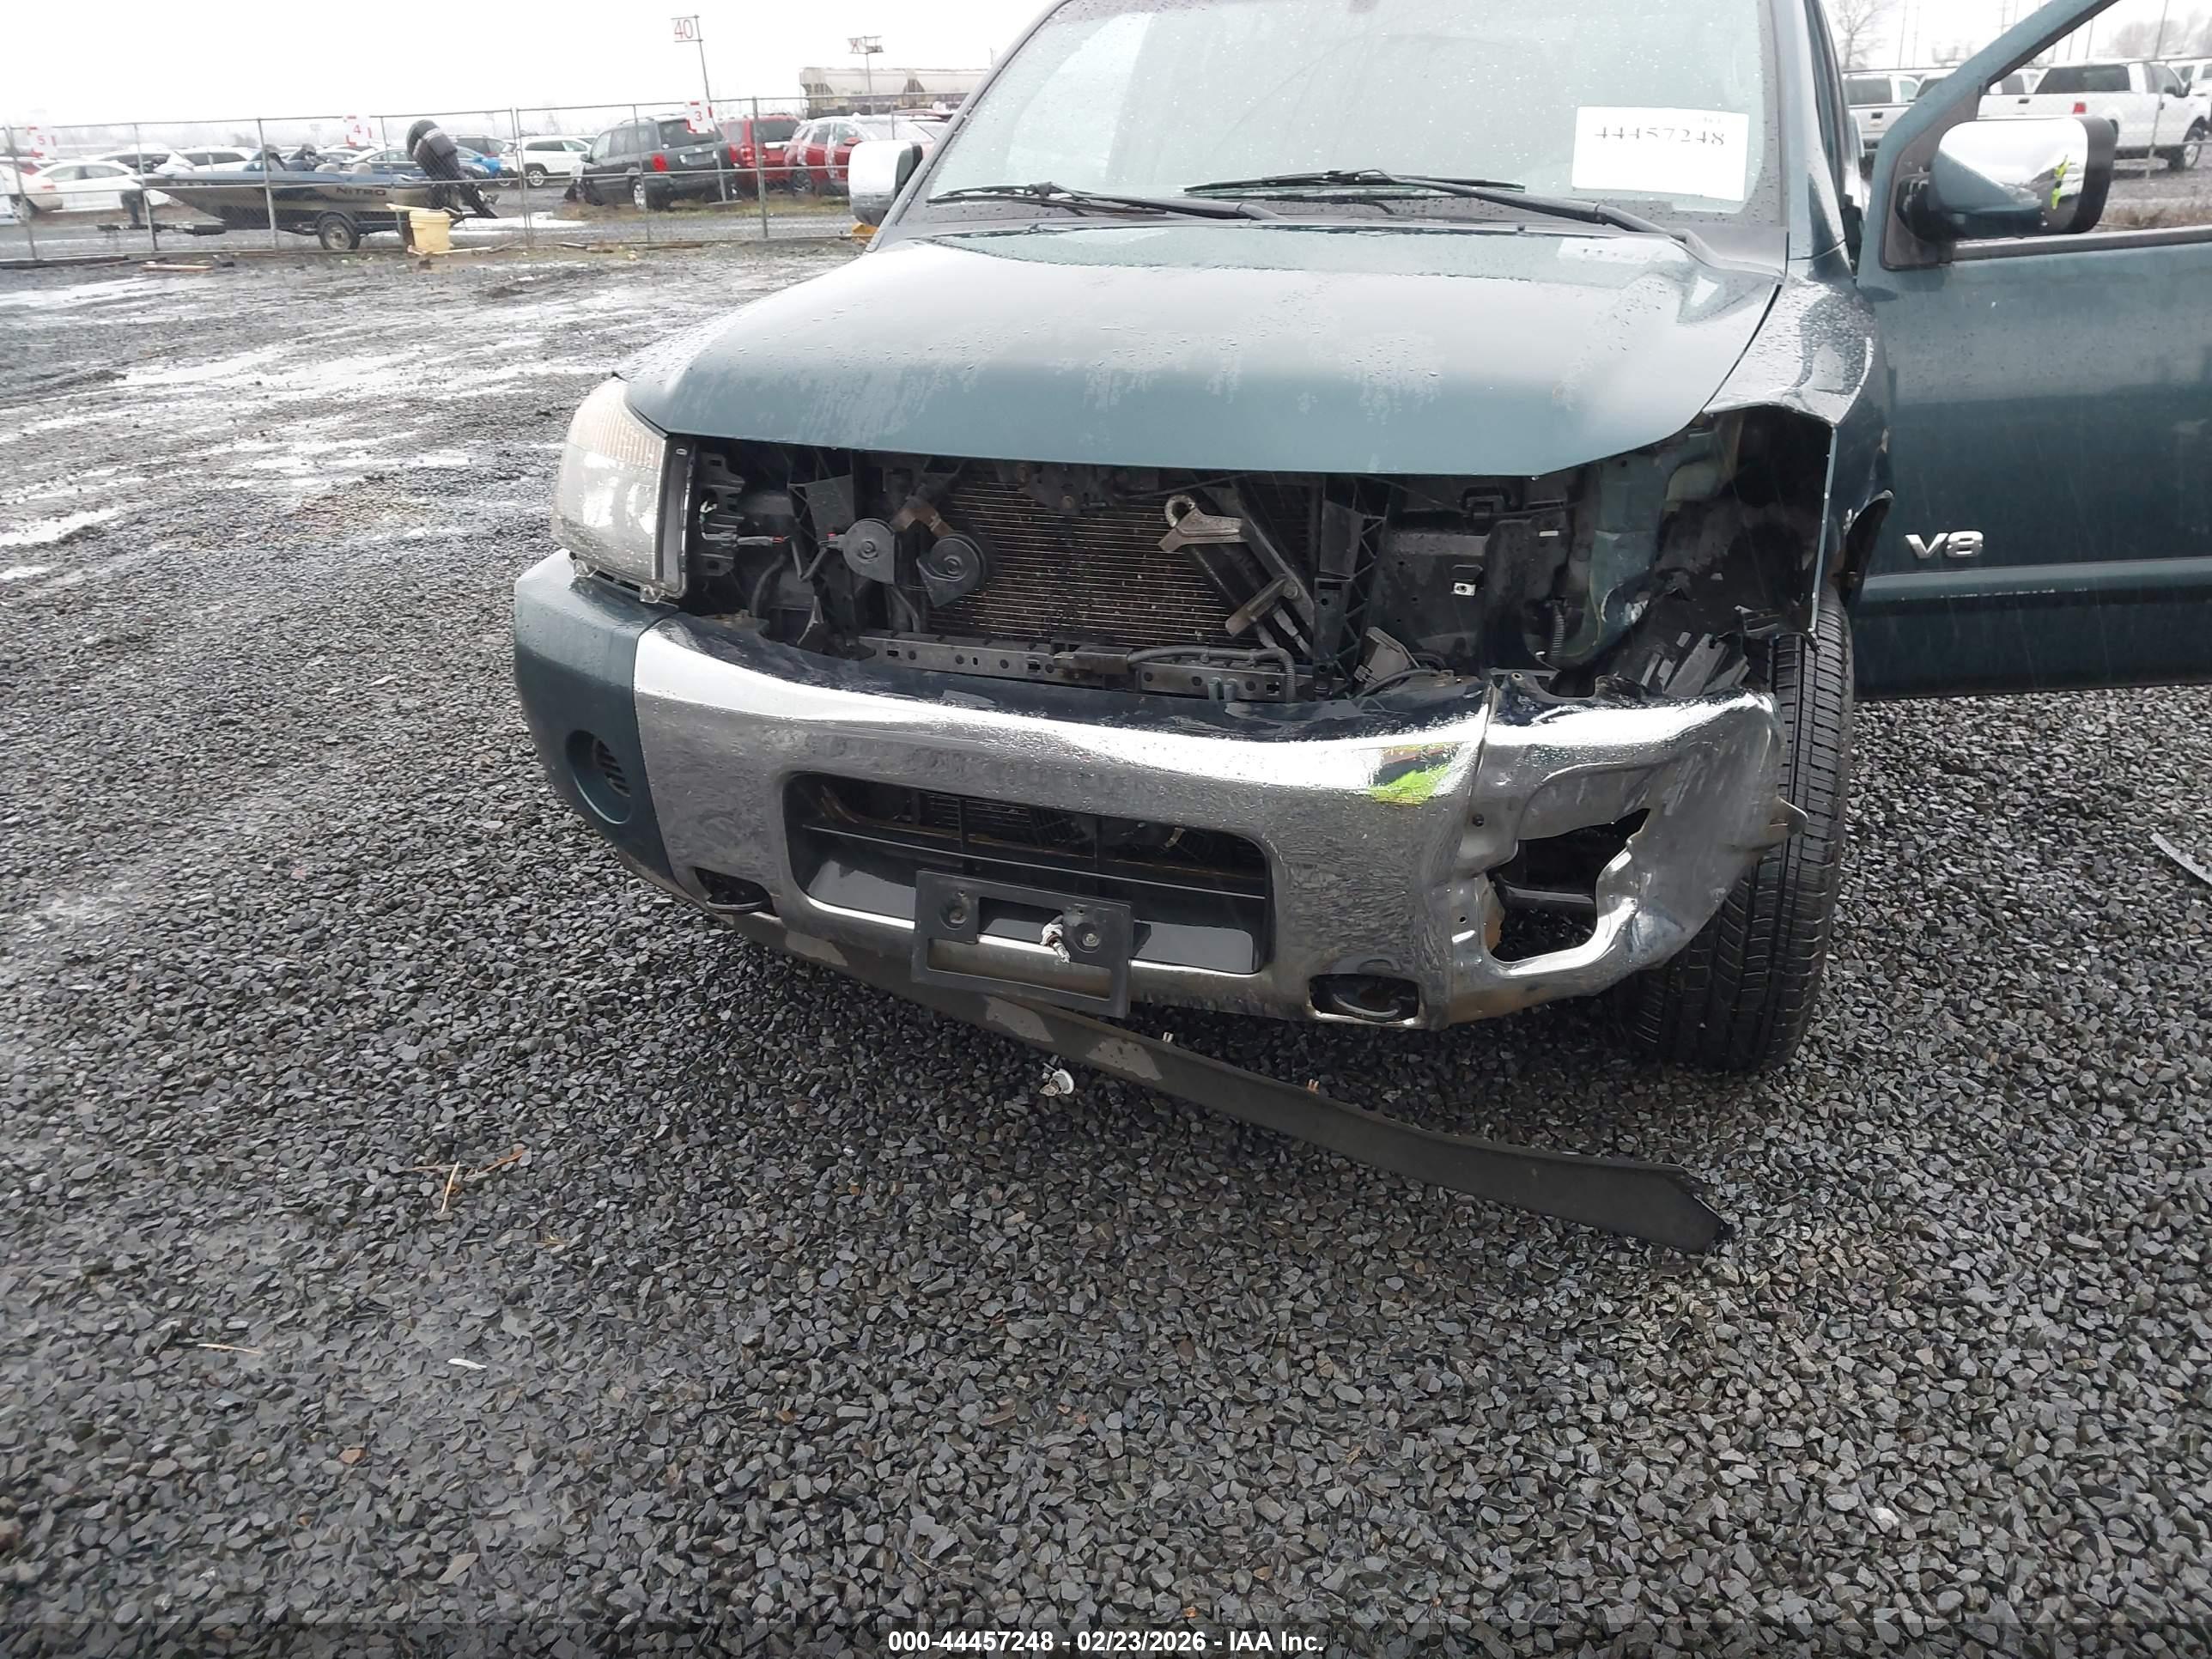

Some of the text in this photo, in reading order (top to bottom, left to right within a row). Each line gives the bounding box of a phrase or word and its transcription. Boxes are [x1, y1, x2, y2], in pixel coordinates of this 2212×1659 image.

[674, 19, 694, 39] 40
[695, 111, 702, 122] 3
[353, 125, 363, 134] 4
[36, 134, 46, 145] 5
[336, 186, 386, 196] NITRO
[1904, 530, 1984, 559] V8
